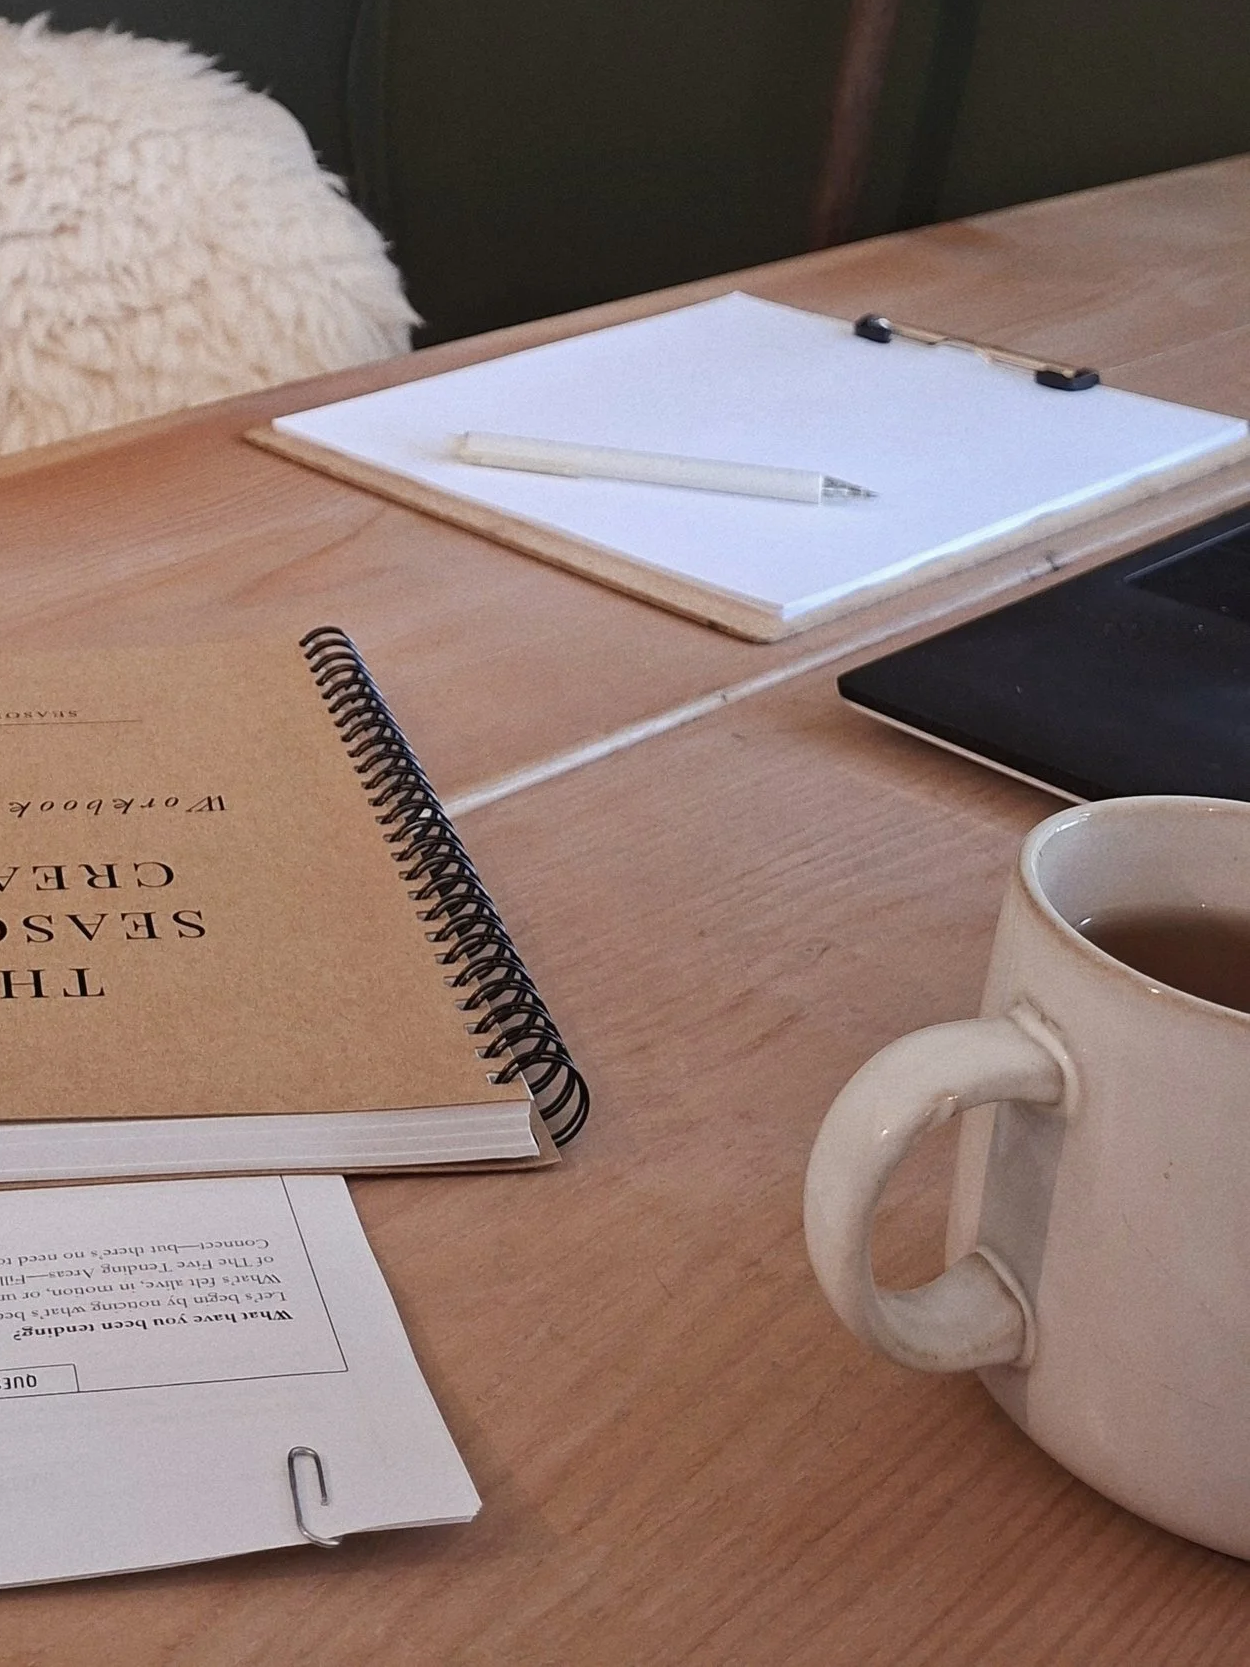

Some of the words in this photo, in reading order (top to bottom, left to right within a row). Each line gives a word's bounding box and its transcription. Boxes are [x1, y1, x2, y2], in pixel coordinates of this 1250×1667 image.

[8, 795, 226, 819] Workbook
[17, 1253, 58, 1267] need
[62, 1251, 85, 1260] no
[256, 1256, 275, 1268] of
[100, 1262, 174, 1276] Tending
[176, 1259, 214, 1271] Five
[218, 1257, 254, 1269] The
[118, 1282, 136, 1294] in
[139, 1279, 184, 1292] alive,
[188, 1276, 216, 1289] felt
[21, 1290, 41, 1300] or
[45, 1284, 114, 1297] motion,
[167, 1297, 189, 1309] by
[192, 1292, 241, 1305] begin
[89, 1299, 162, 1312] noticing
[152, 1312, 189, 1327] you
[192, 1312, 238, 1324] have
[240, 1309, 294, 1322] What
[100, 1319, 148, 1331] been
[12, 1323, 95, 1342] tending?
